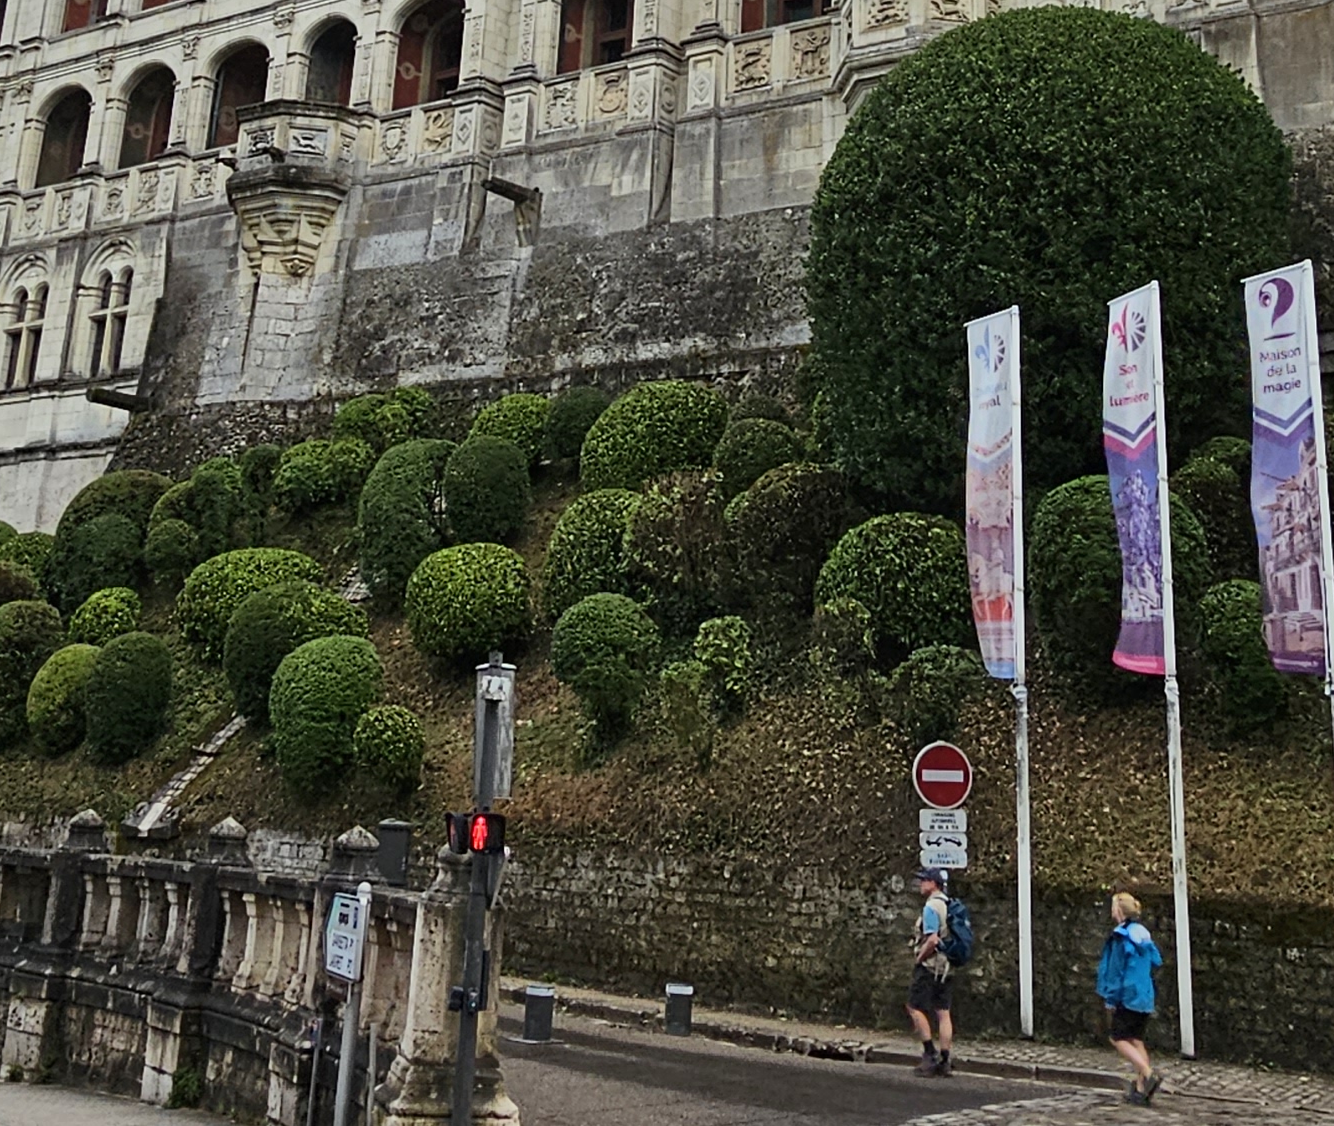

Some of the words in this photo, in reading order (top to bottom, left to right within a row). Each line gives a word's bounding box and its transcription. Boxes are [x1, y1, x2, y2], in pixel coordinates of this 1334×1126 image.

[1259, 347, 1301, 363] Maison
[1119, 364, 1138, 376] Son
[1267, 365, 1283, 378] de
[1286, 363, 1297, 375] la
[1263, 377, 1301, 394] magie
